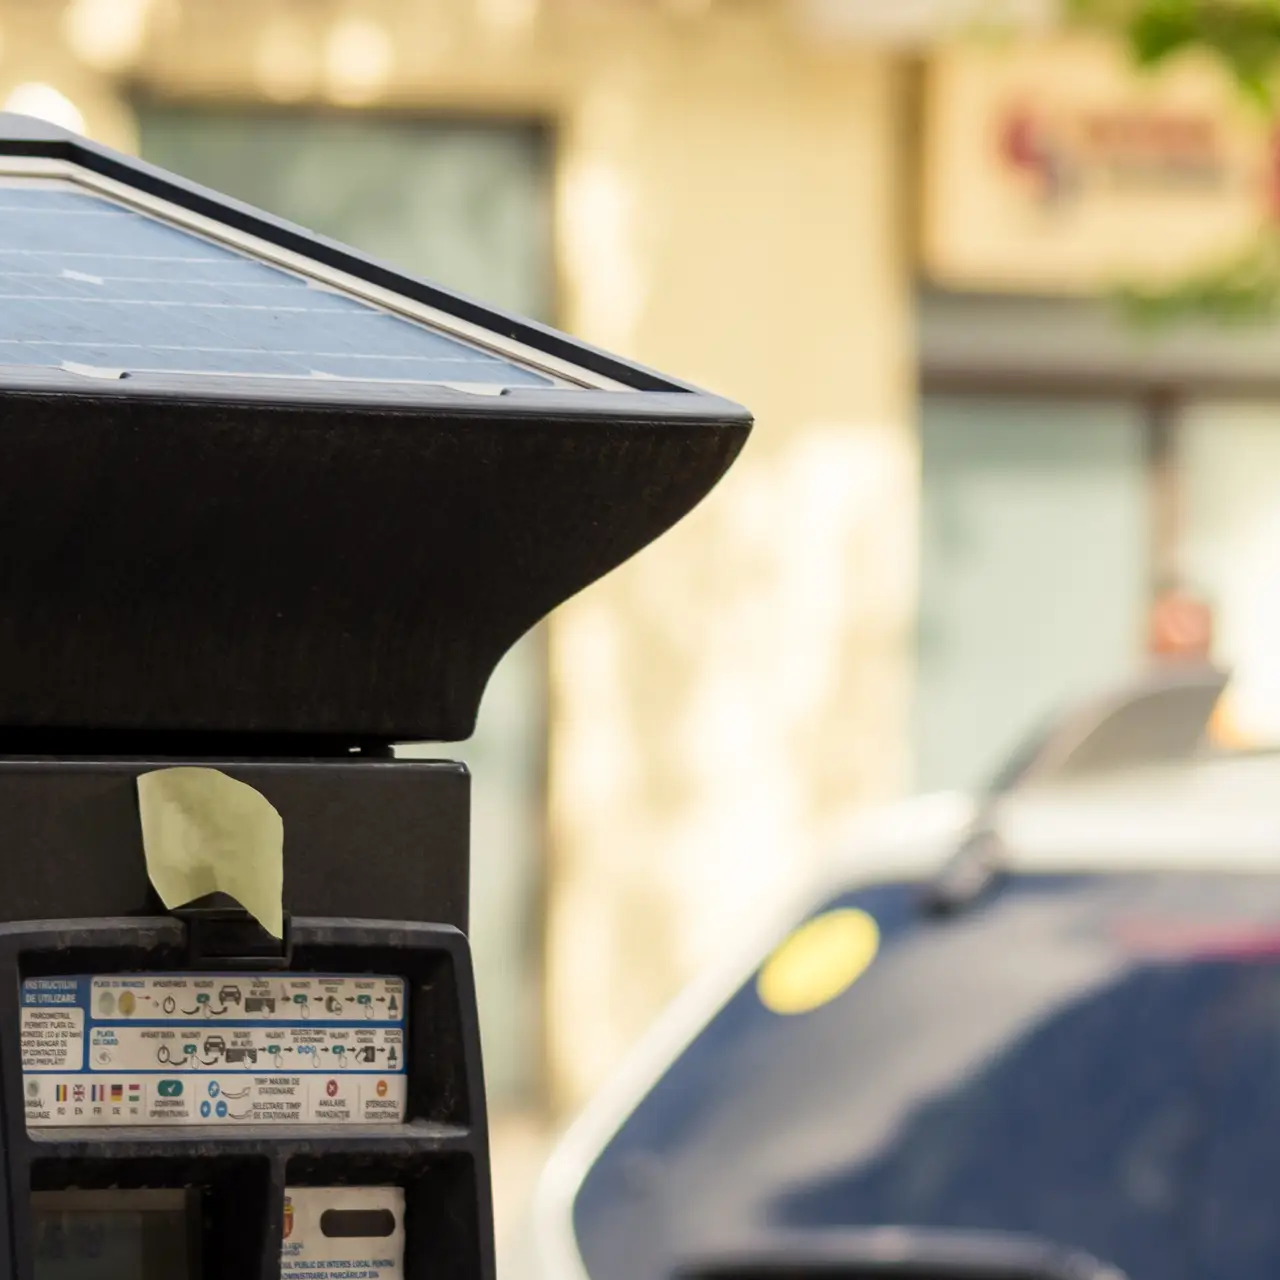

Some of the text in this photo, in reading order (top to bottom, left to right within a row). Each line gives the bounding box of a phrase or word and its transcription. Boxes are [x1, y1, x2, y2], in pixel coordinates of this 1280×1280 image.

[25, 994, 77, 1003] DE UTILIZARE
[291, 1077, 300, 1085] DE
[252, 1102, 284, 1110] SELECTARE
[75, 1107, 83, 1115] EN
[93, 1107, 102, 1115] FR
[111, 1107, 120, 1115] DE
